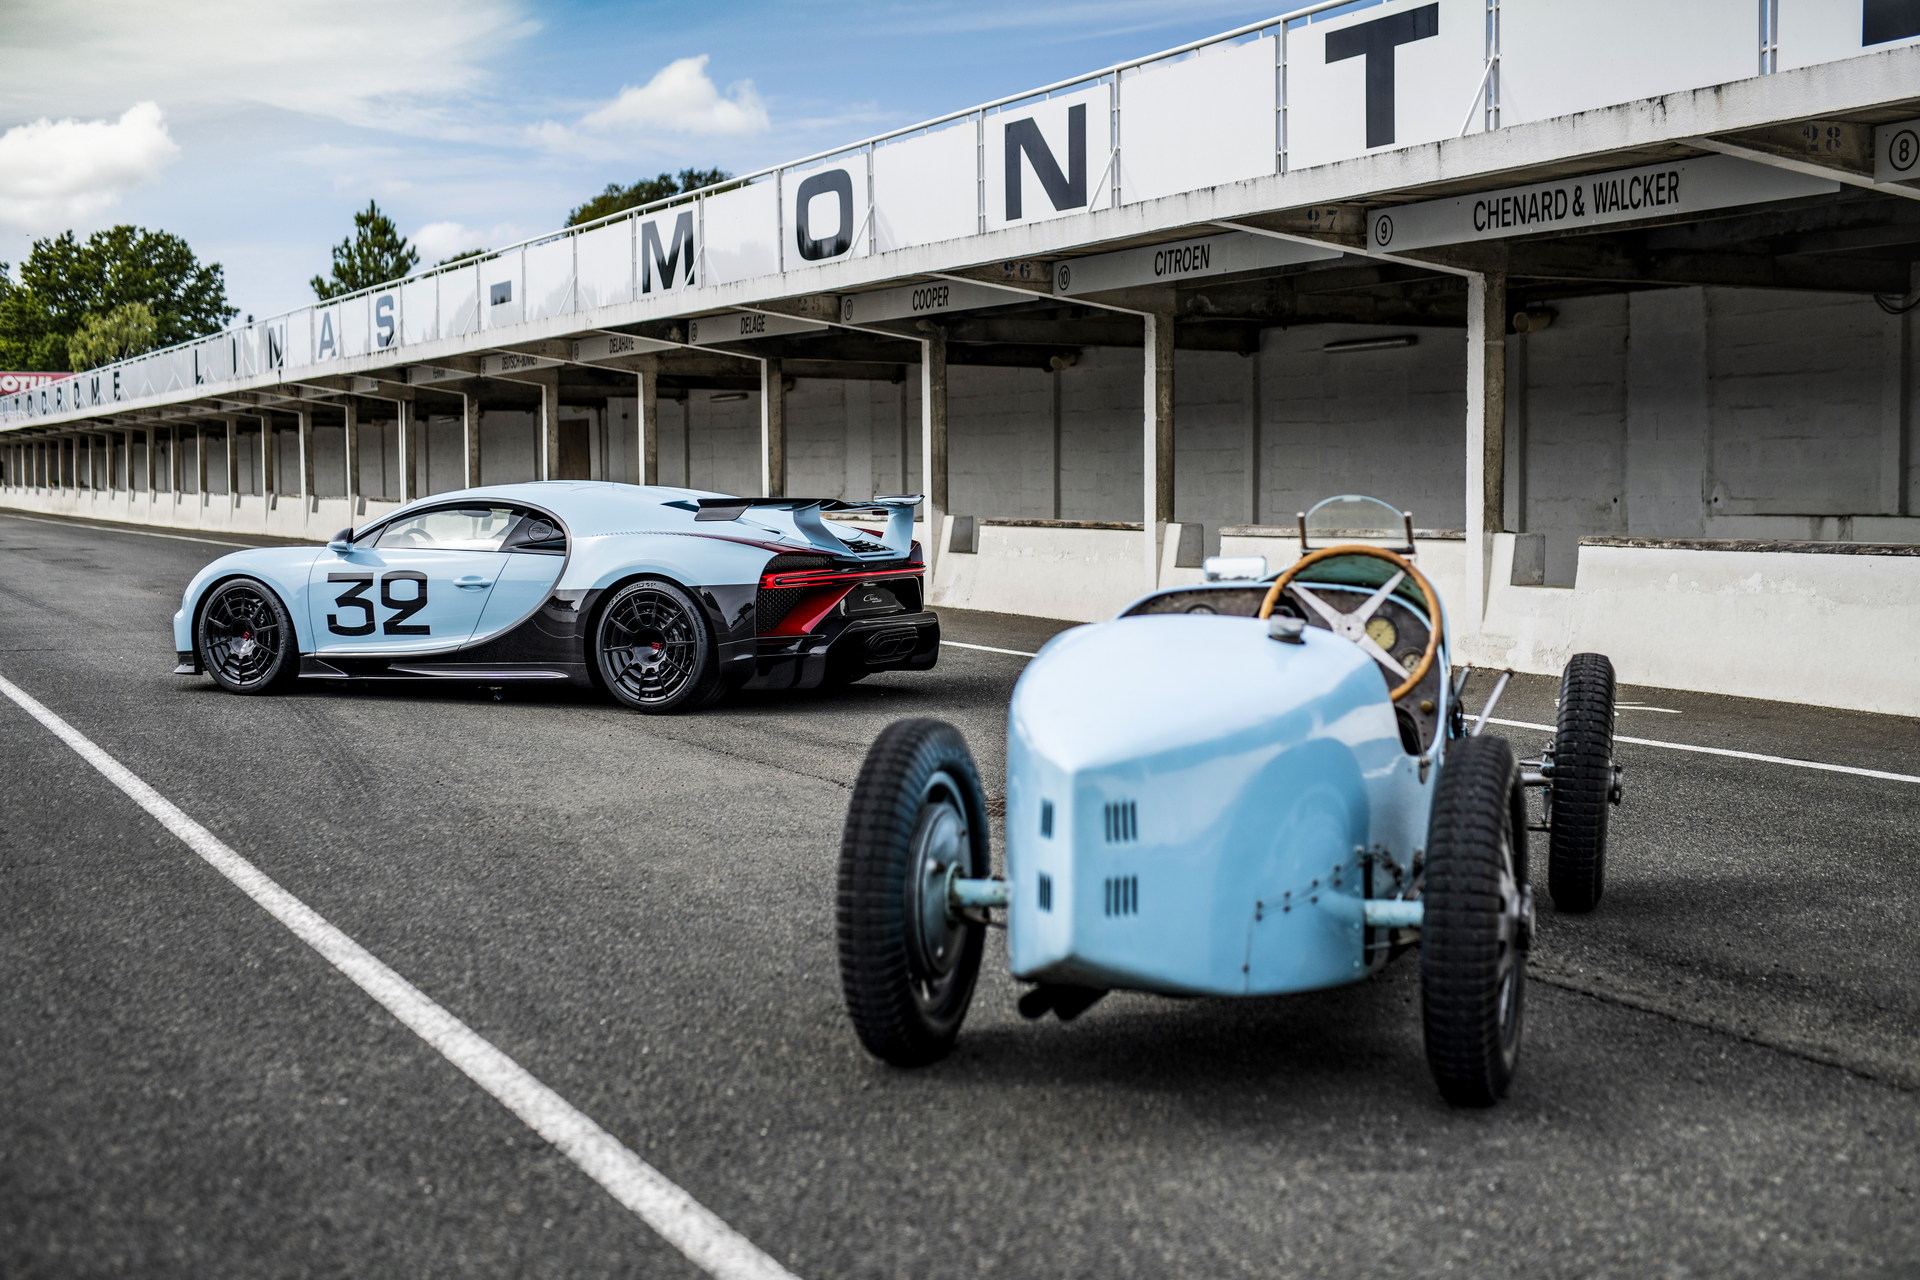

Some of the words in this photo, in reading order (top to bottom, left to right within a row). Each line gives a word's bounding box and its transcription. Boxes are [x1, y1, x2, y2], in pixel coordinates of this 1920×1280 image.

[1473, 188, 1568, 232] CHENARD
[1572, 185, 1585, 217] &
[1593, 171, 1680, 214] WALCKER
[1154, 243, 1210, 276] CITROEN
[912, 285, 949, 311] COOPER
[195, 295, 395, 385] LINAS
[740, 314, 766, 335] DELAGE
[326, 570, 431, 636] 32
